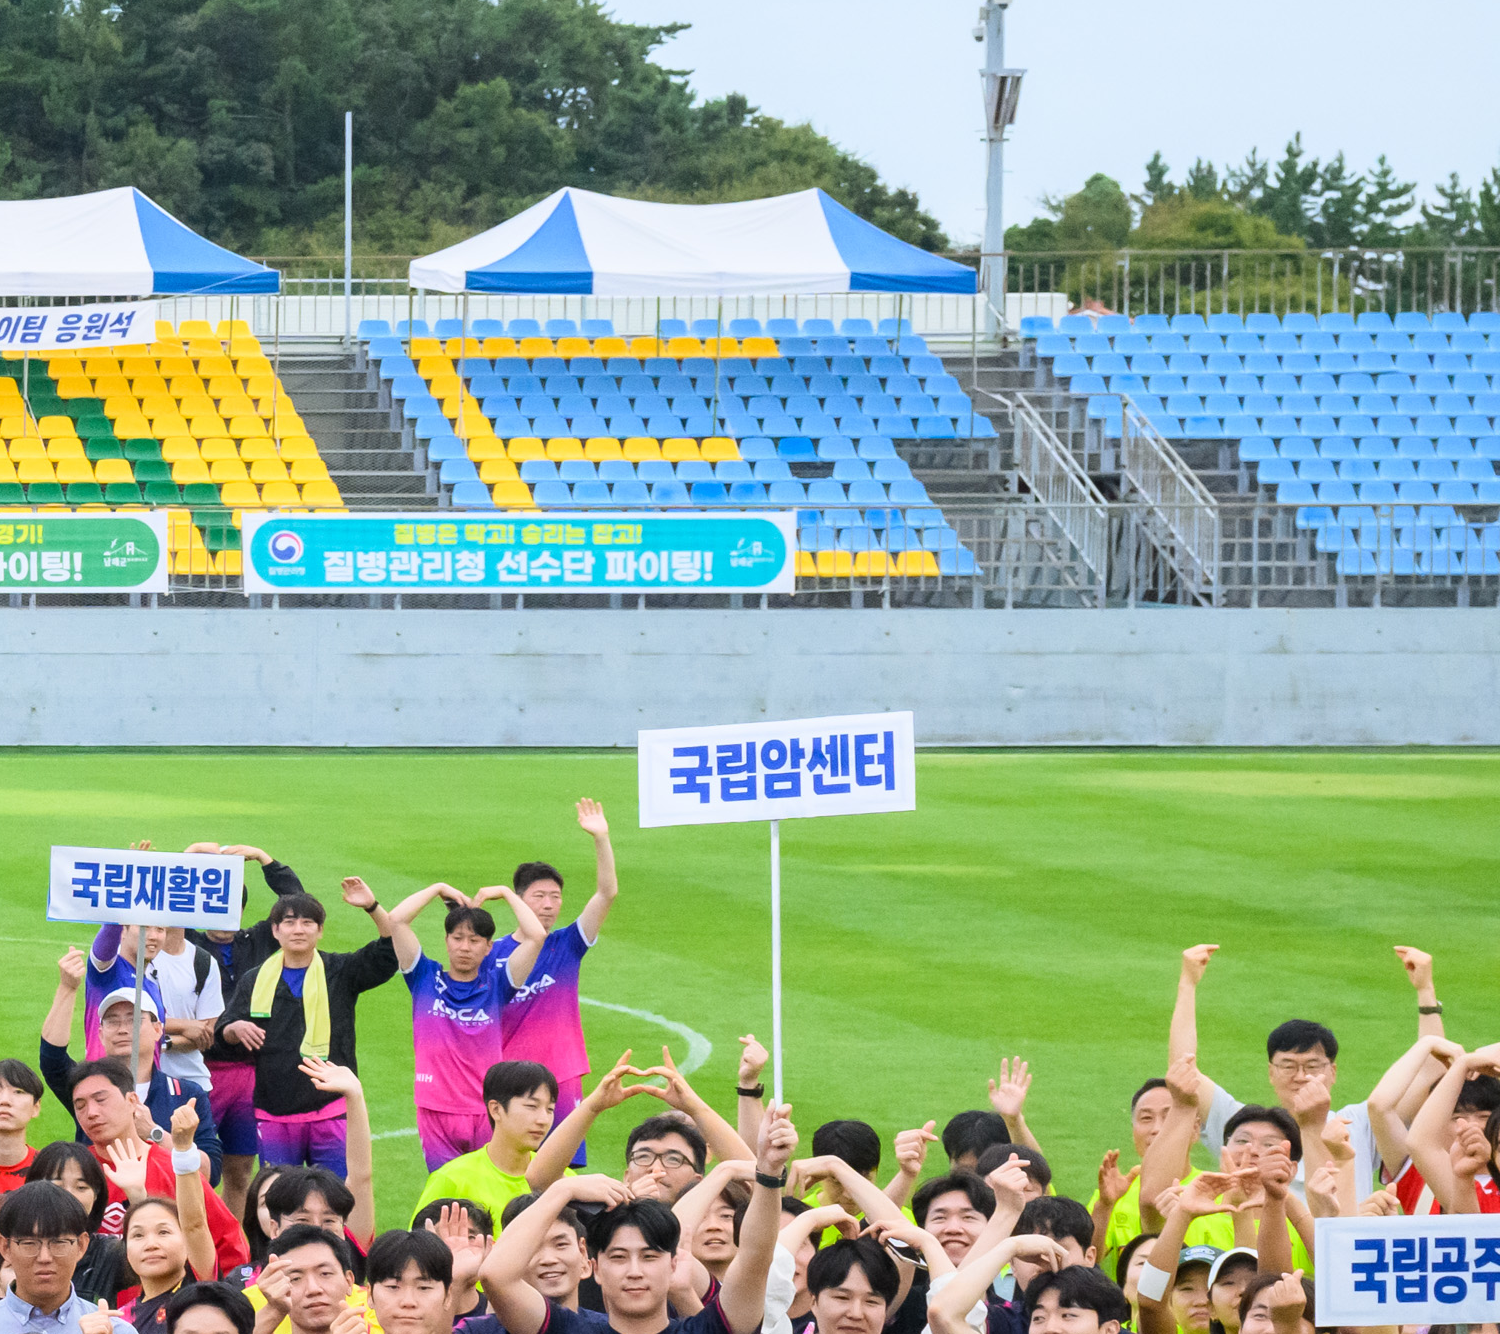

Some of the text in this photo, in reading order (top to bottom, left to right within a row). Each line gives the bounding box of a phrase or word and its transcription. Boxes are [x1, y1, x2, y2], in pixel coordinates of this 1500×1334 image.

[56, 310, 136, 343] 응원석
[395, 524, 457, 544] 질병은
[465, 524, 514, 544] 막고!
[522, 524, 585, 544] 승리는
[324, 551, 712, 582] 질병관리청 선수단 파이팅!
[669, 731, 895, 804] 국립암센터
[71, 861, 231, 915] 국립재활원
